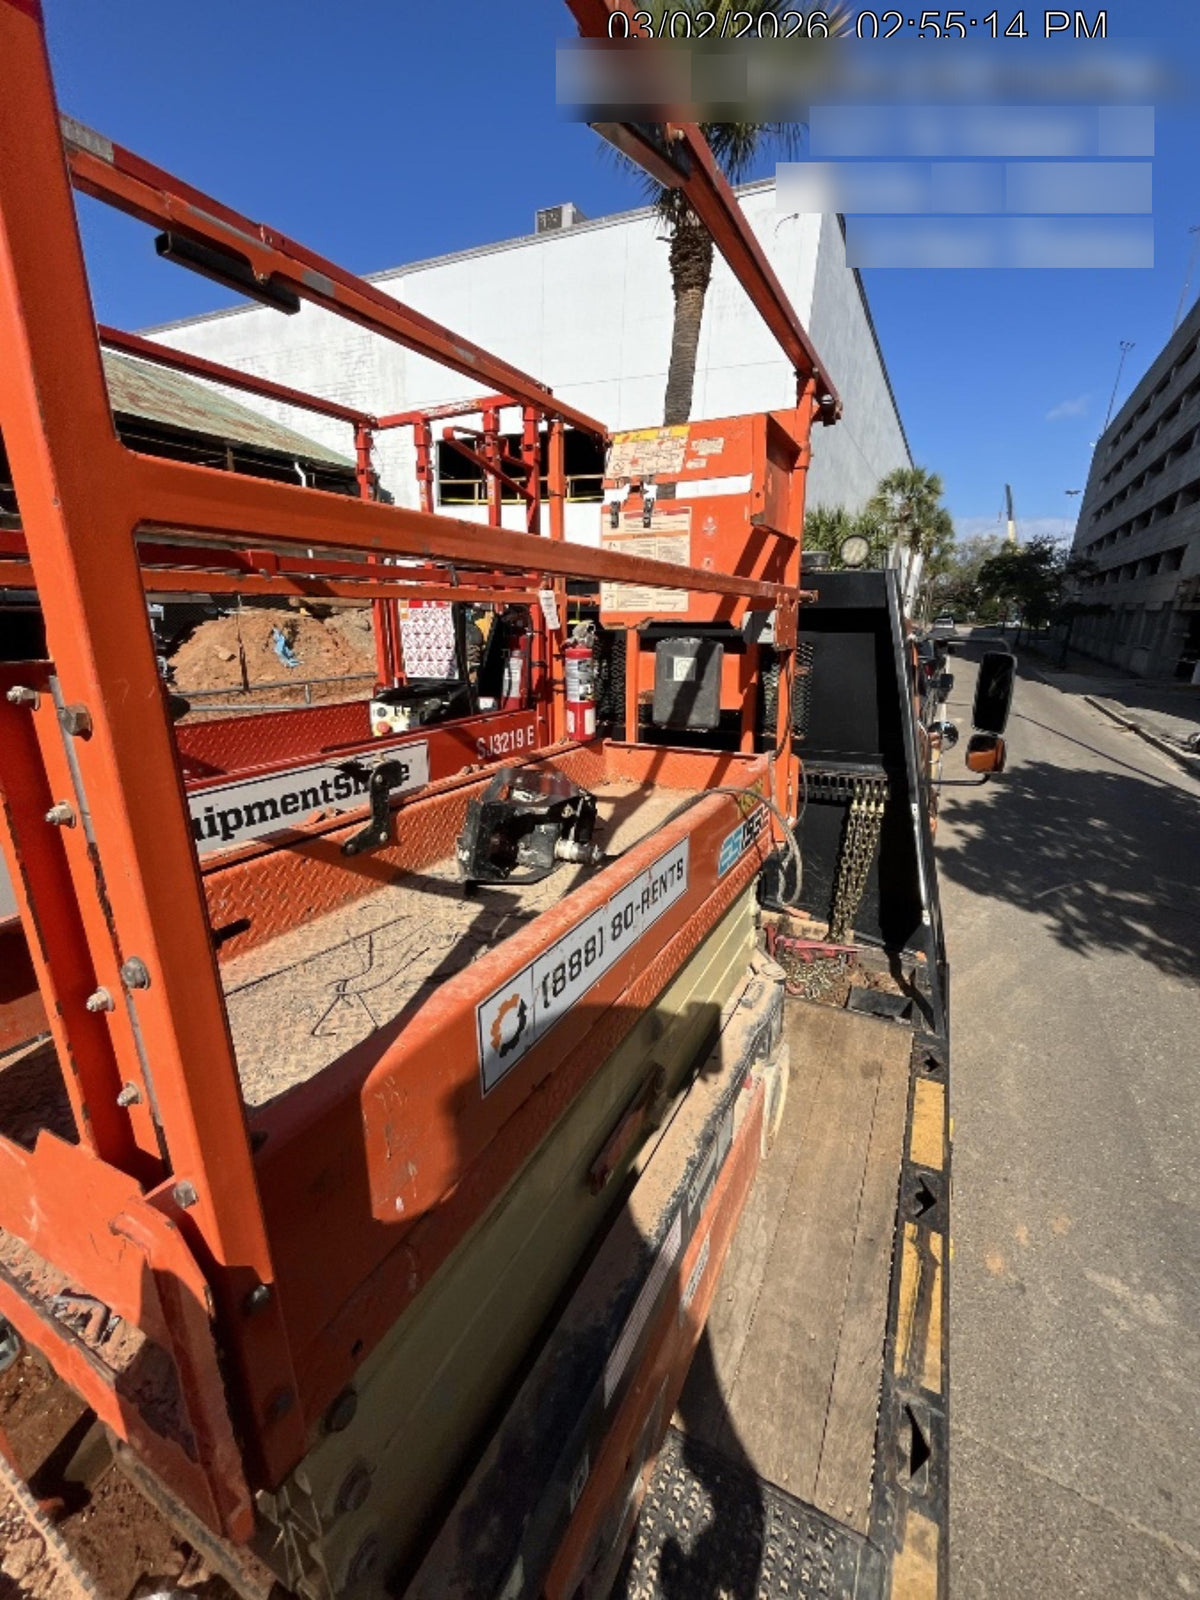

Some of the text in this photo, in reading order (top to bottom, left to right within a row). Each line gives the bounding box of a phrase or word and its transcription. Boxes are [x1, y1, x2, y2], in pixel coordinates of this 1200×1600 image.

[476, 725, 535, 760] SJ3219 E
[611, 857, 684, 941] 80-RENTS
